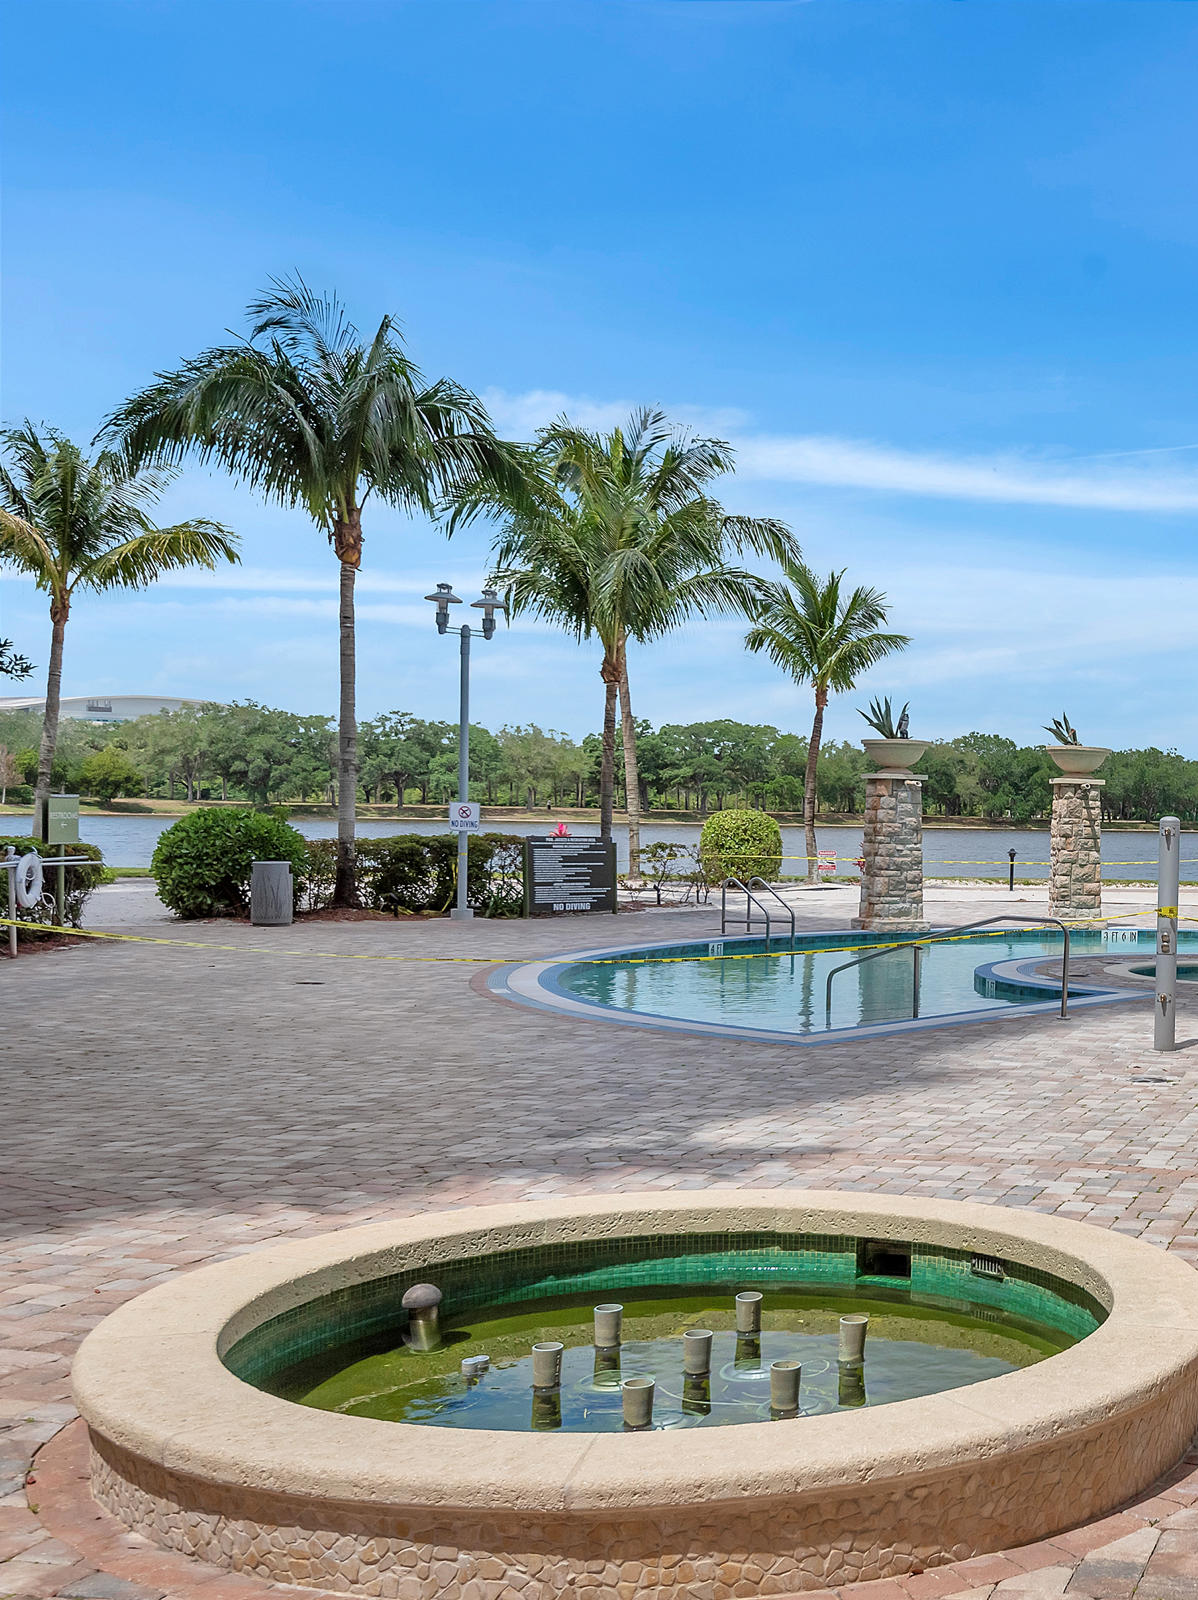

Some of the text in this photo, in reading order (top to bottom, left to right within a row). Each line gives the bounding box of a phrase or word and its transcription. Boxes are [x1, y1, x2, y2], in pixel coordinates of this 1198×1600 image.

[460, 820, 478, 828] DIVING
[553, 903, 564, 911] NO
[1111, 932, 1118, 942] FT
